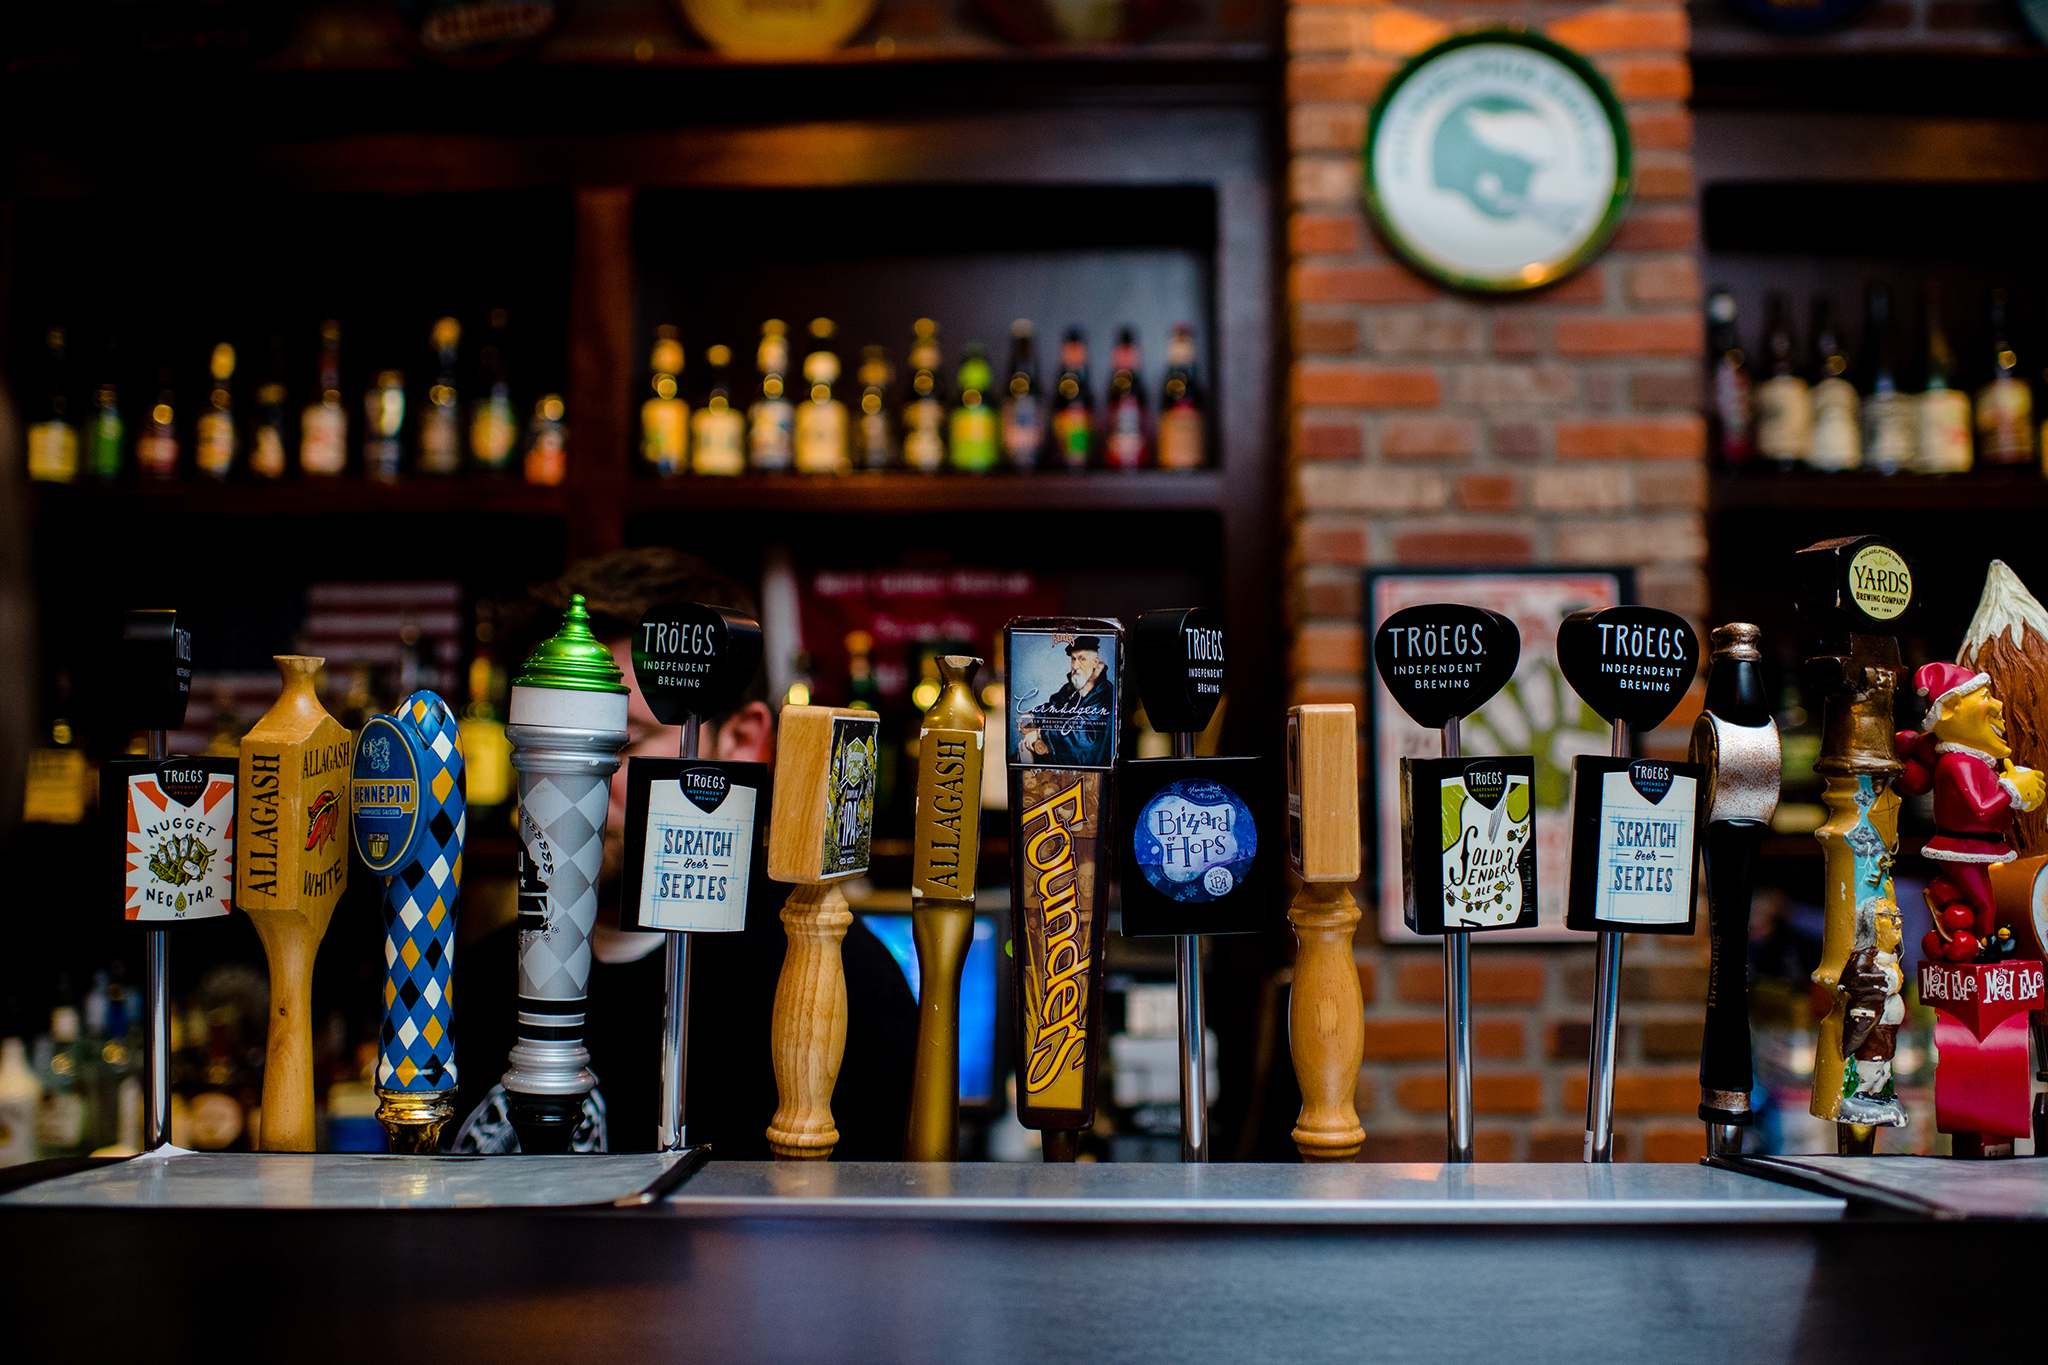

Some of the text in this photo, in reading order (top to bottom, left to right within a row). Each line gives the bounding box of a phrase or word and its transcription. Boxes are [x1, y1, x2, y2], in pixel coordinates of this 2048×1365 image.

[1853, 565, 1909, 595] YARDS
[1856, 592, 1907, 606] BREWING COMPANY
[643, 661, 711, 673] INDEPENDENT
[1189, 668, 1223, 678] INDEPENDENT
[1394, 663, 1482, 675] INDEPENDENT
[1601, 663, 1682, 677] INDEPENDENT
[658, 676, 700, 688] BREWING
[1198, 683, 1219, 693] BREWING
[1415, 679, 1470, 689] BREWING
[1620, 679, 1670, 692] BREWING
[302, 740, 350, 779] ALLAGASH
[354, 784, 411, 804] HENNEPIN
[382, 808, 400, 816] SAISON
[926, 738, 967, 891] ALLAGASH
[1154, 806, 1231, 836] Blizzard
[146, 817, 216, 838] NUGGET
[247, 752, 281, 897] ALLAGASH
[1617, 821, 1677, 848] SCRATCH
[371, 842, 384, 857] ALE
[664, 828, 733, 856] SCRATCH
[683, 858, 709, 869] Beer
[1634, 850, 1657, 861] Beer
[303, 858, 343, 897] WHITE
[660, 872, 728, 901] SERIES
[1210, 876, 1228, 889] IPA
[1614, 865, 1673, 893] SERIES
[146, 885, 214, 907] NECTAR
[1475, 884, 1491, 897] ALE
[1022, 777, 1091, 1095] Founders
[1921, 966, 1976, 1000] Mad Elf
[1983, 968, 2043, 1003] Mad Elf
